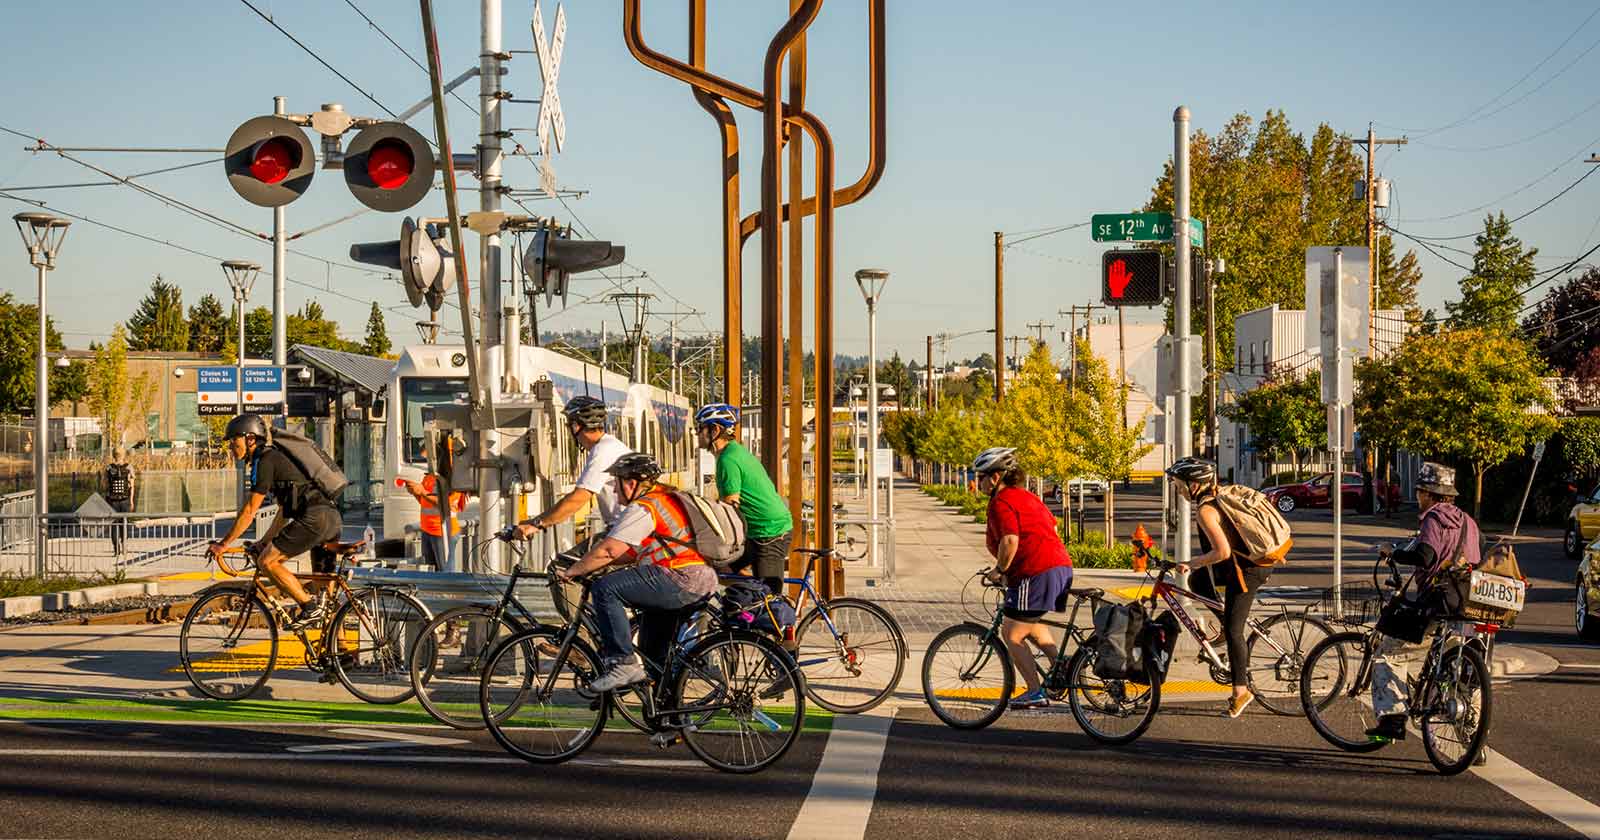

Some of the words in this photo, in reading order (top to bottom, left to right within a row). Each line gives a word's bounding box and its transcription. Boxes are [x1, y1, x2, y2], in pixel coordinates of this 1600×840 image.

[1099, 224, 1112, 235] SE
[1119, 218, 1145, 235] 12th
[200, 405, 213, 413] City
